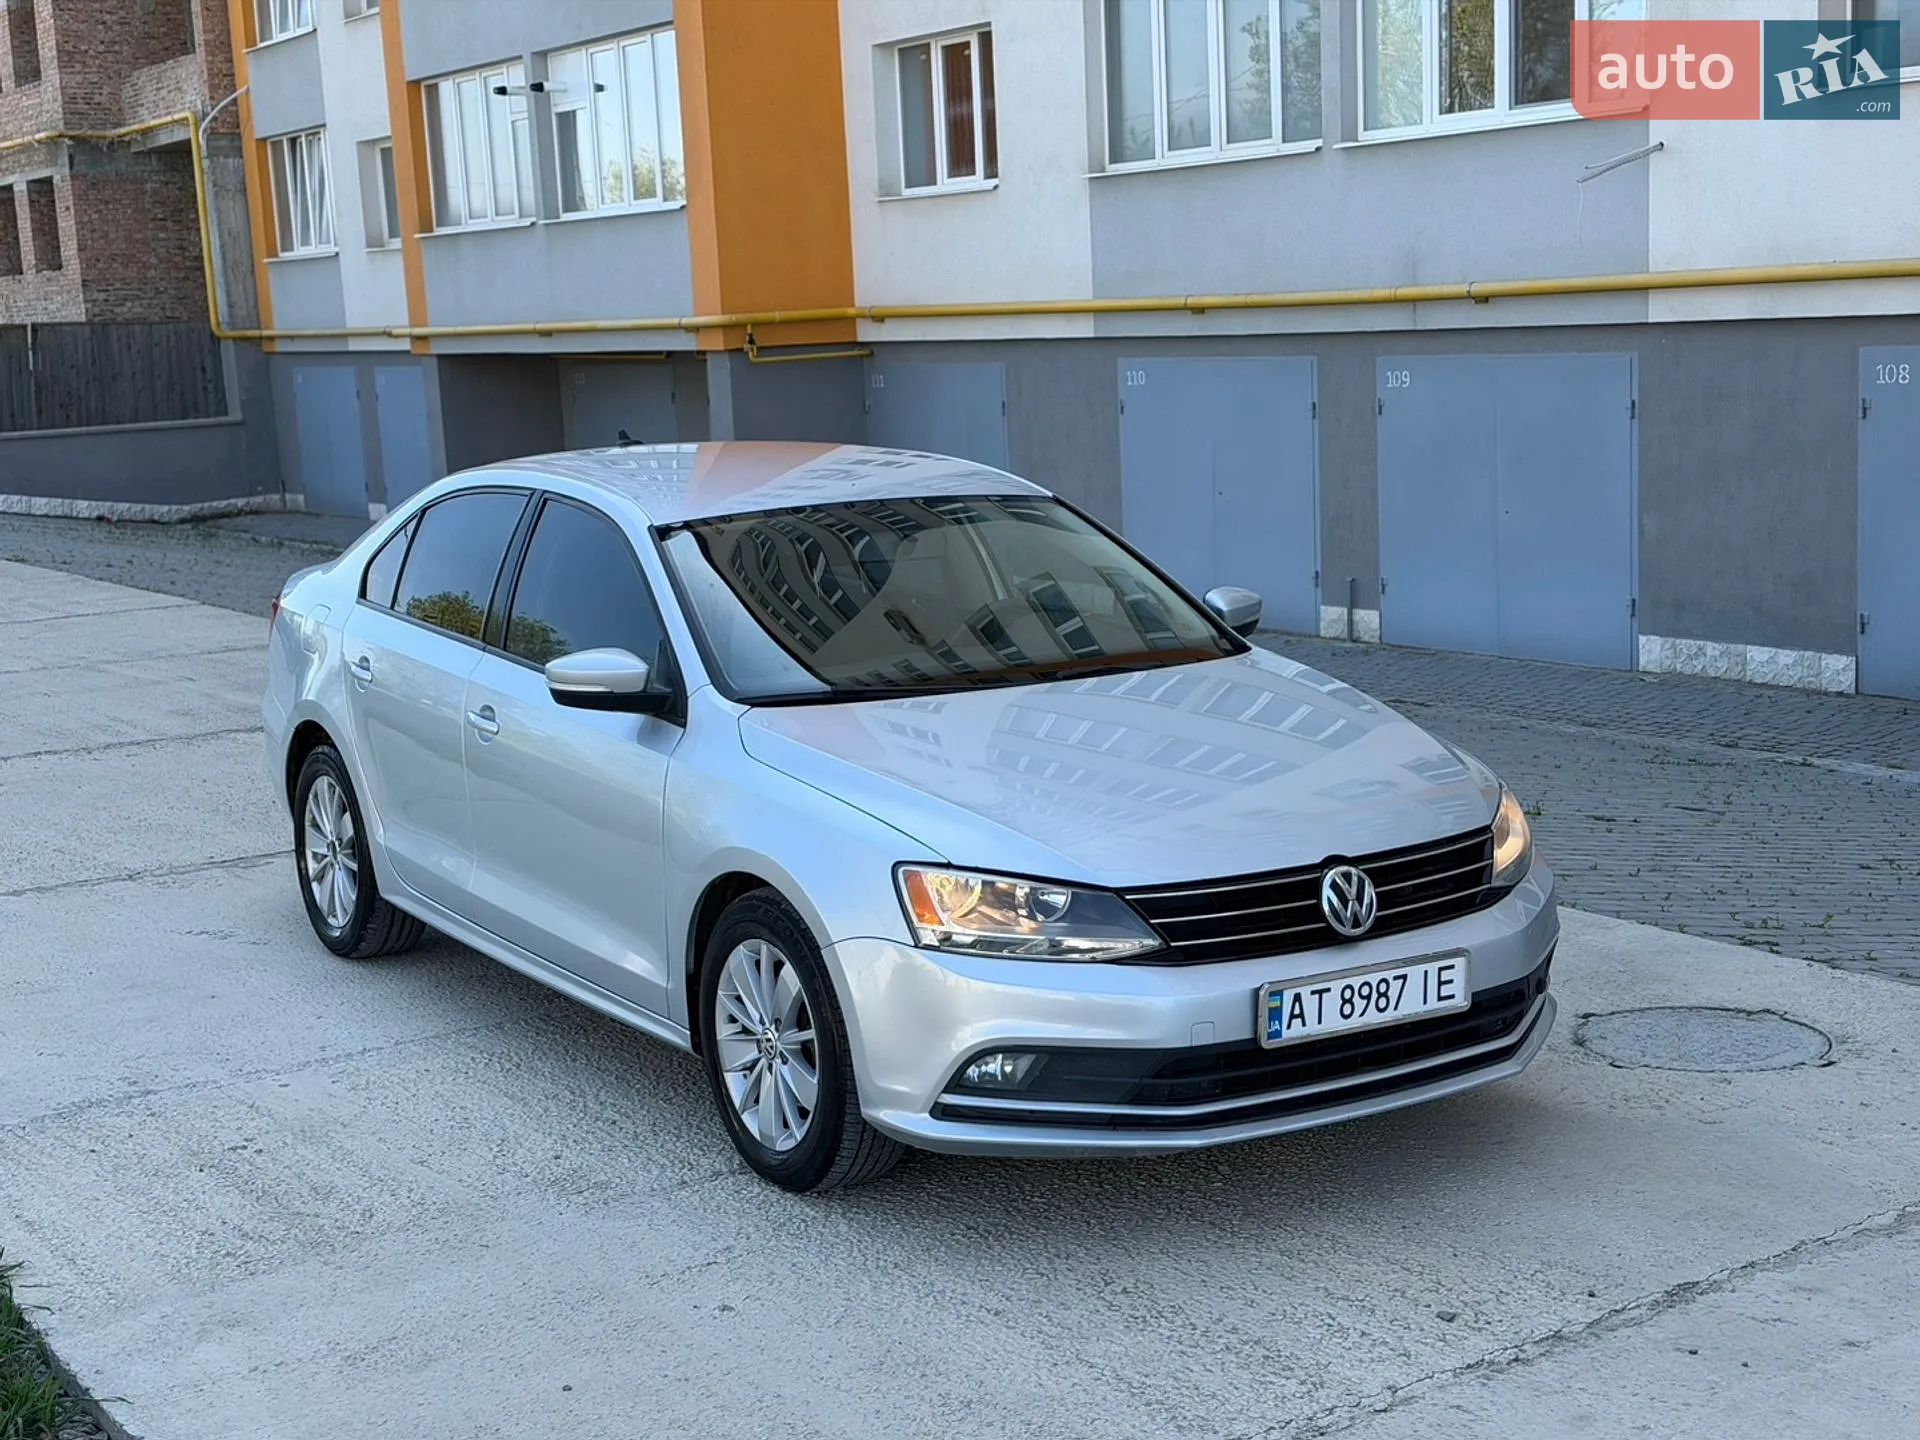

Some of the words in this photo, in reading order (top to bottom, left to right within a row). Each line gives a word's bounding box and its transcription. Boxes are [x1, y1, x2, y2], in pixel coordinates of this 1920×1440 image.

[1125, 370, 1145, 386] 110
[1386, 370, 1410, 388] 109
[1875, 363, 1910, 384] 108
[1286, 987, 1331, 1031] AT
[1338, 973, 1408, 1021] 8987
[1423, 964, 1456, 1006] IE
